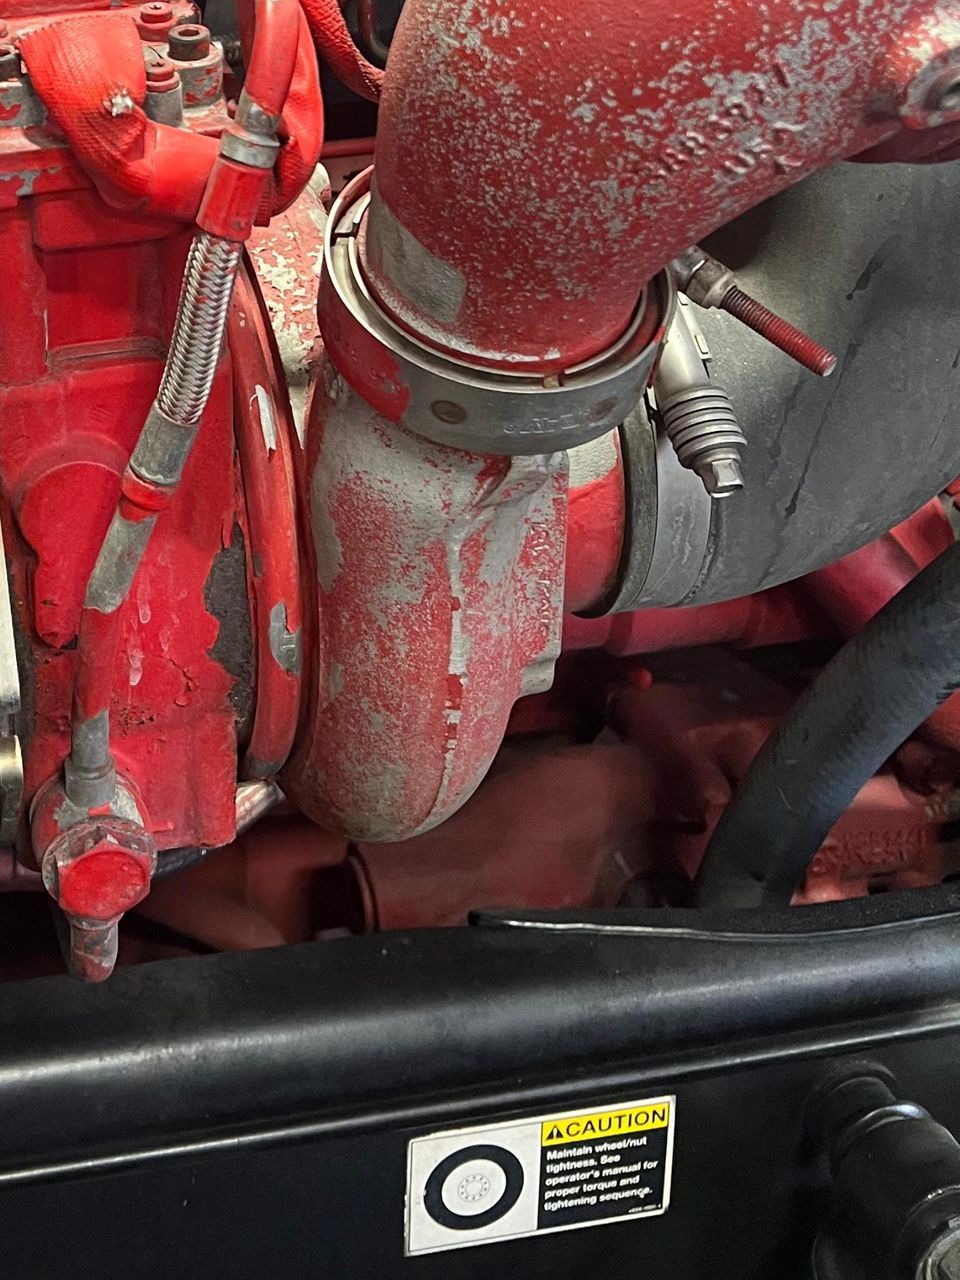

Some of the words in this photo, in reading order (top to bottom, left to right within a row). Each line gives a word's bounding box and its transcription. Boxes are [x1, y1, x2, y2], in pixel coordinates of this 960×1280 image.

[565, 1108, 666, 1137] CAUTION
[546, 1146, 593, 1161] Maintain
[594, 1135, 647, 1153] wheel/nut
[544, 1170, 600, 1187] operator's
[601, 1161, 642, 1177] manual
[642, 1160, 659, 1170] for
[545, 1158, 598, 1174] tightness.
[599, 1154, 621, 1165] See
[543, 1195, 597, 1212] tightening
[598, 1186, 654, 1202] sequence.
[544, 1185, 581, 1201] proper
[582, 1180, 618, 1194] torque
[619, 1174, 641, 1186] and
